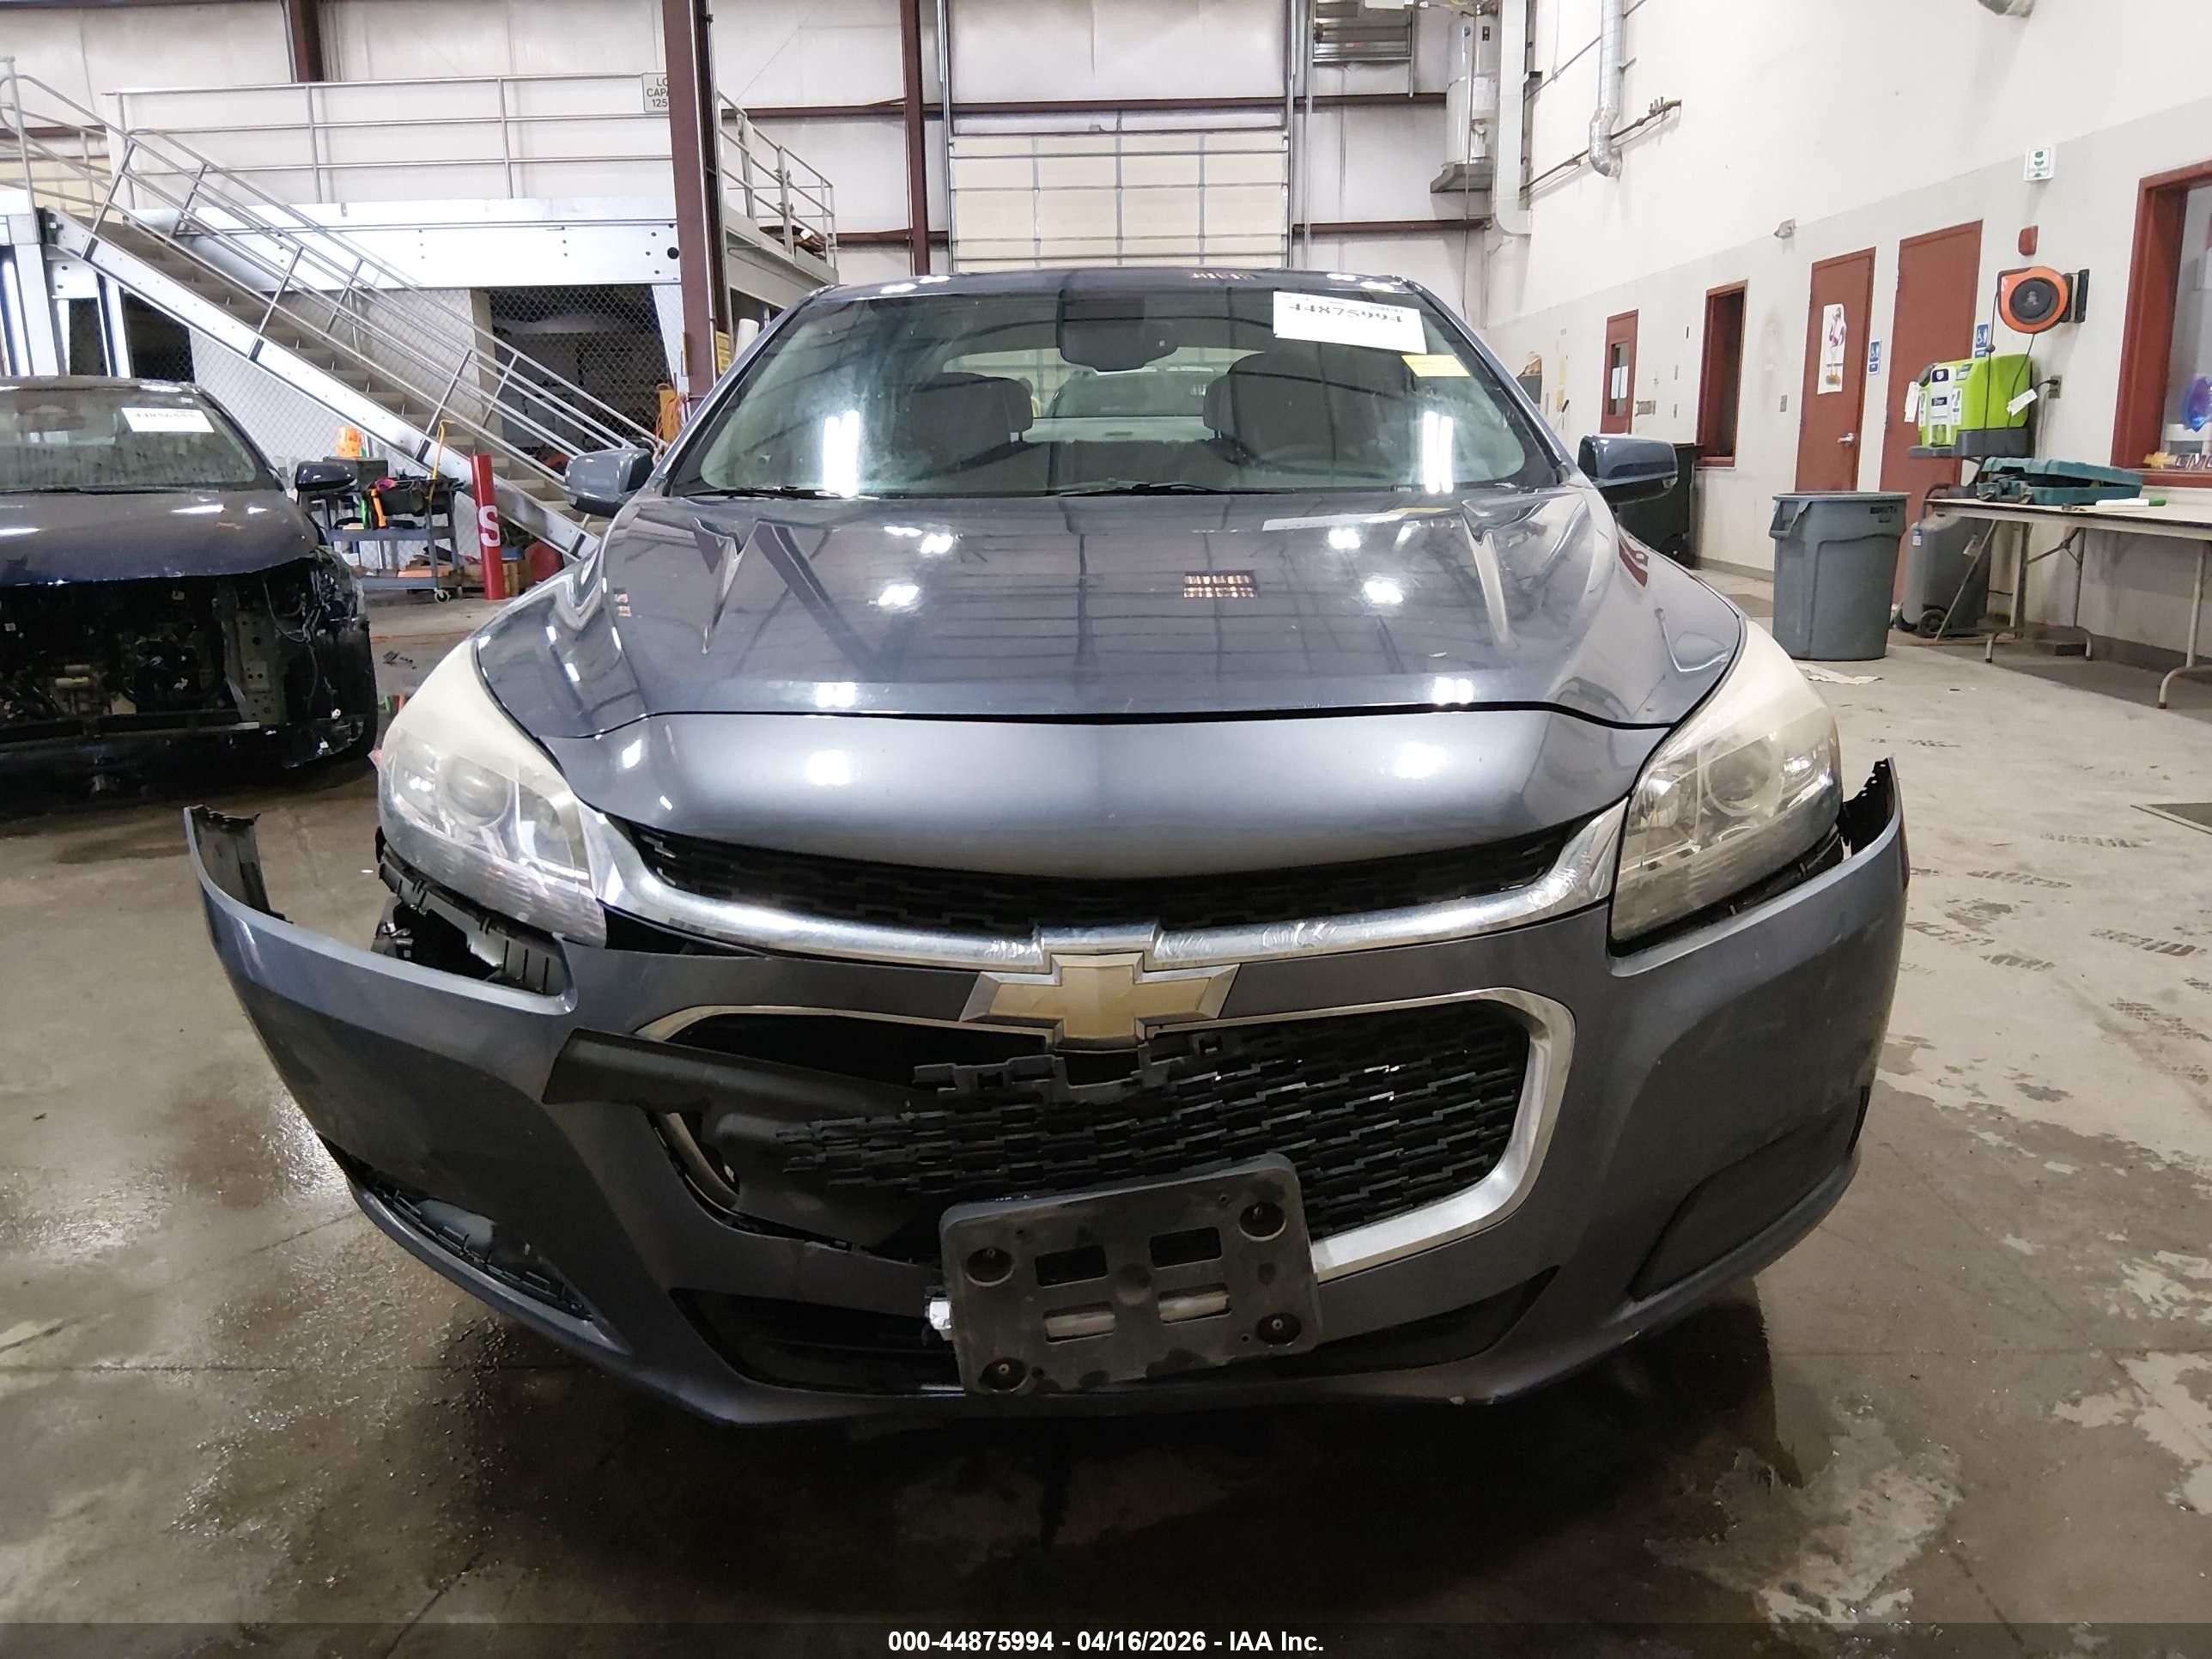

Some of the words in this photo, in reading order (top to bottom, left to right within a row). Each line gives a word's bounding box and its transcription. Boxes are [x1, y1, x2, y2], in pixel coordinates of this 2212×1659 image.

[656, 77, 668, 87] LO
[1288, 302, 1403, 324] 44875994
[478, 505, 501, 548] S
